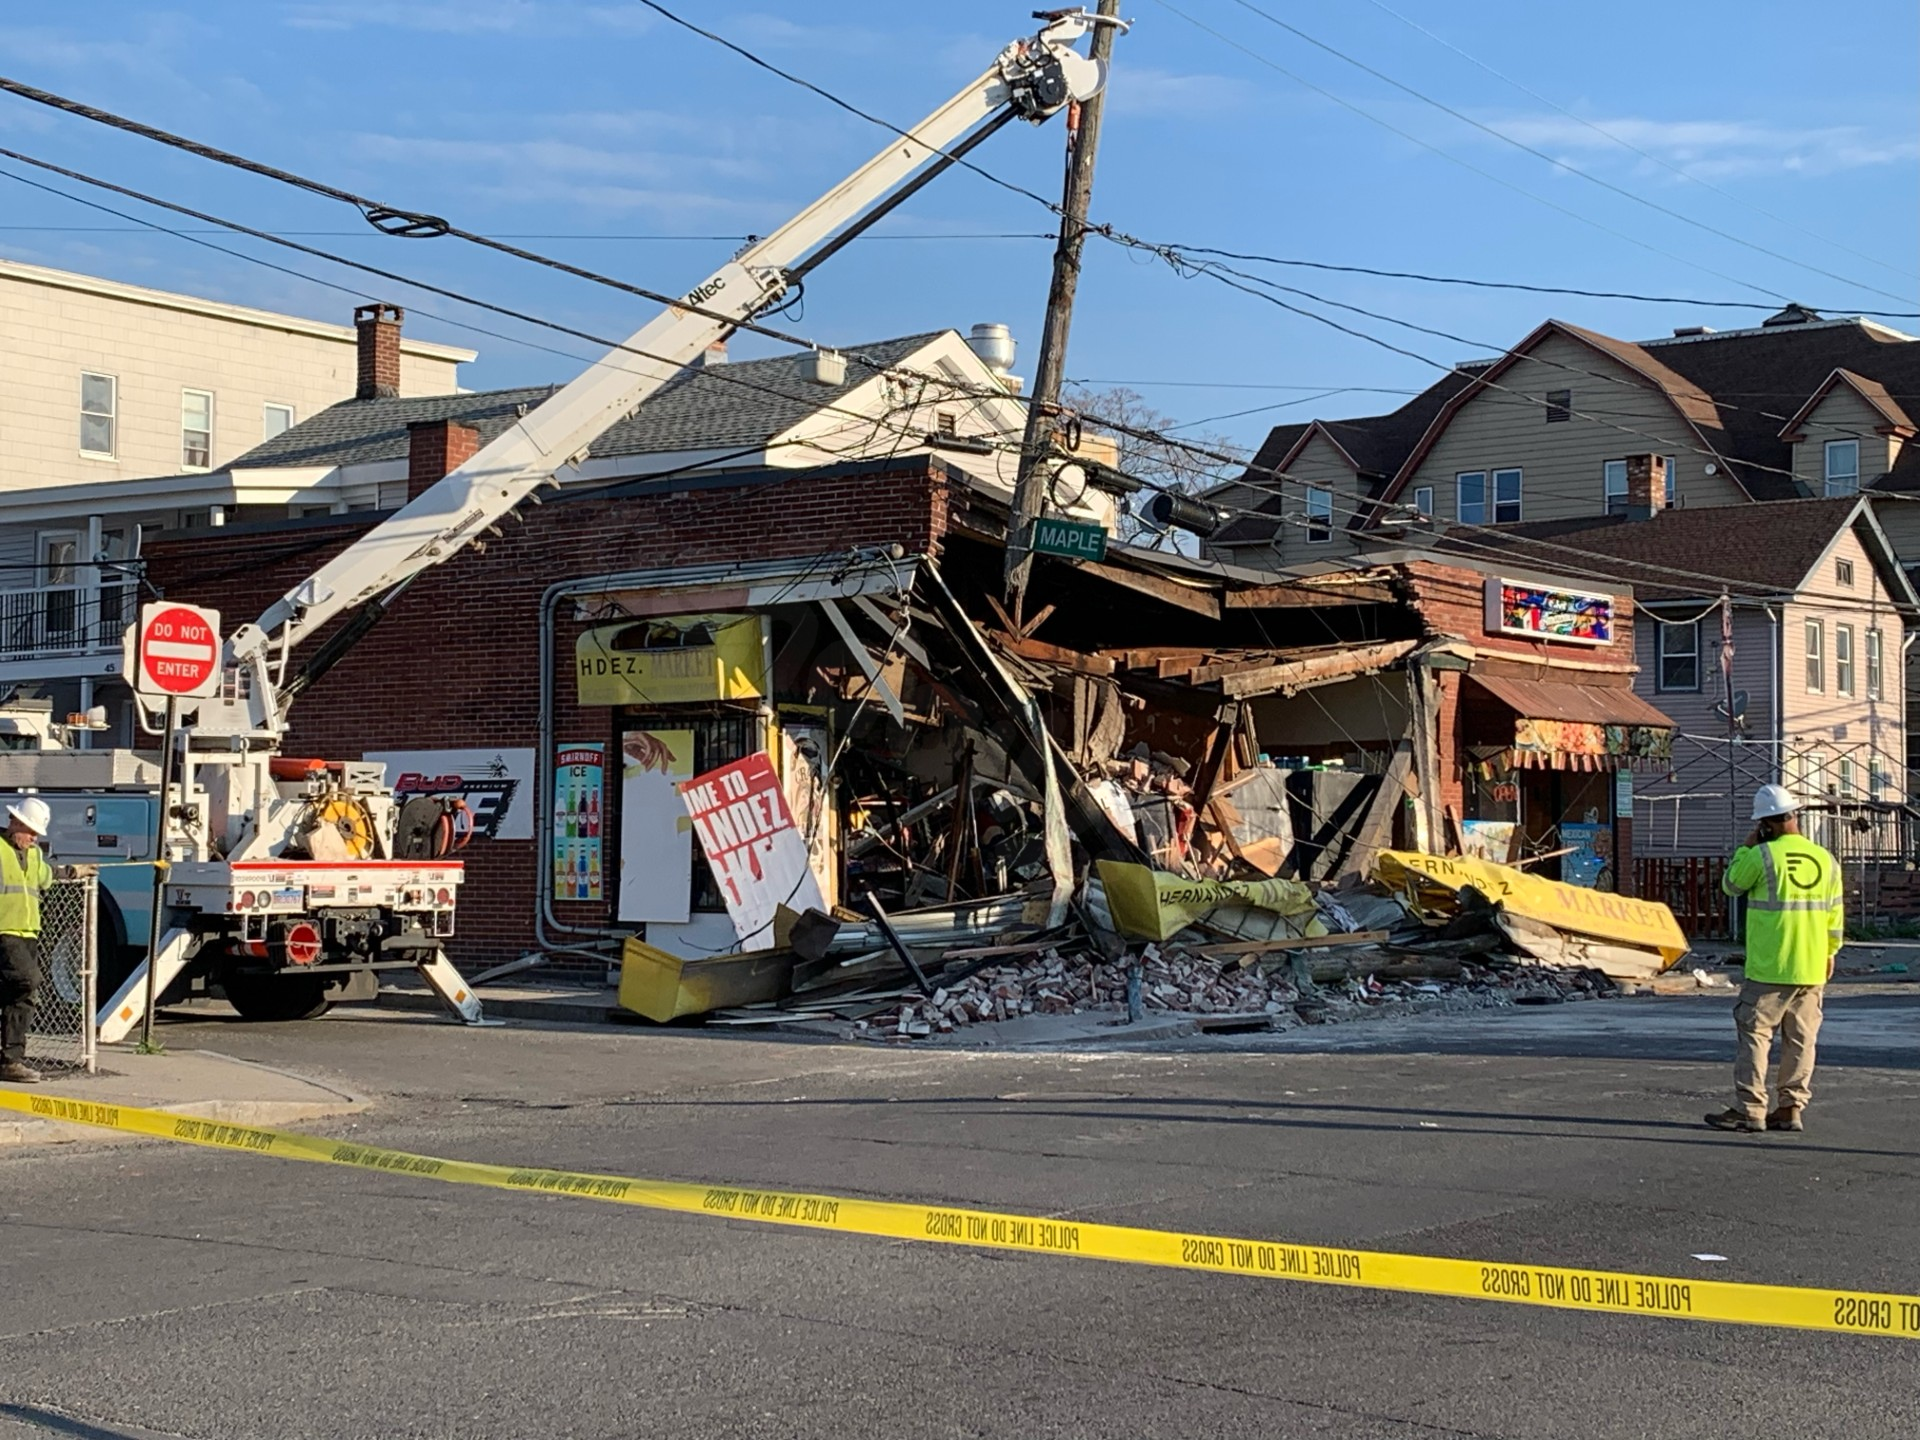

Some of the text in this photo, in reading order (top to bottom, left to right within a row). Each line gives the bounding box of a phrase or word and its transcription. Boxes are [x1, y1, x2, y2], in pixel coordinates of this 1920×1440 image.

[688, 277, 726, 306] Altec
[1040, 526, 1101, 552] MAPLE
[154, 623, 207, 640] DO NOT
[104, 663, 115, 672] 45
[157, 661, 199, 678] ENTER
[581, 657, 643, 676] HDEZ.
[561, 752, 599, 764] SMIRNOFF
[569, 766, 587, 777] ICE
[719, 770, 749, 800] TO
[1555, 887, 1670, 931] MARKET
